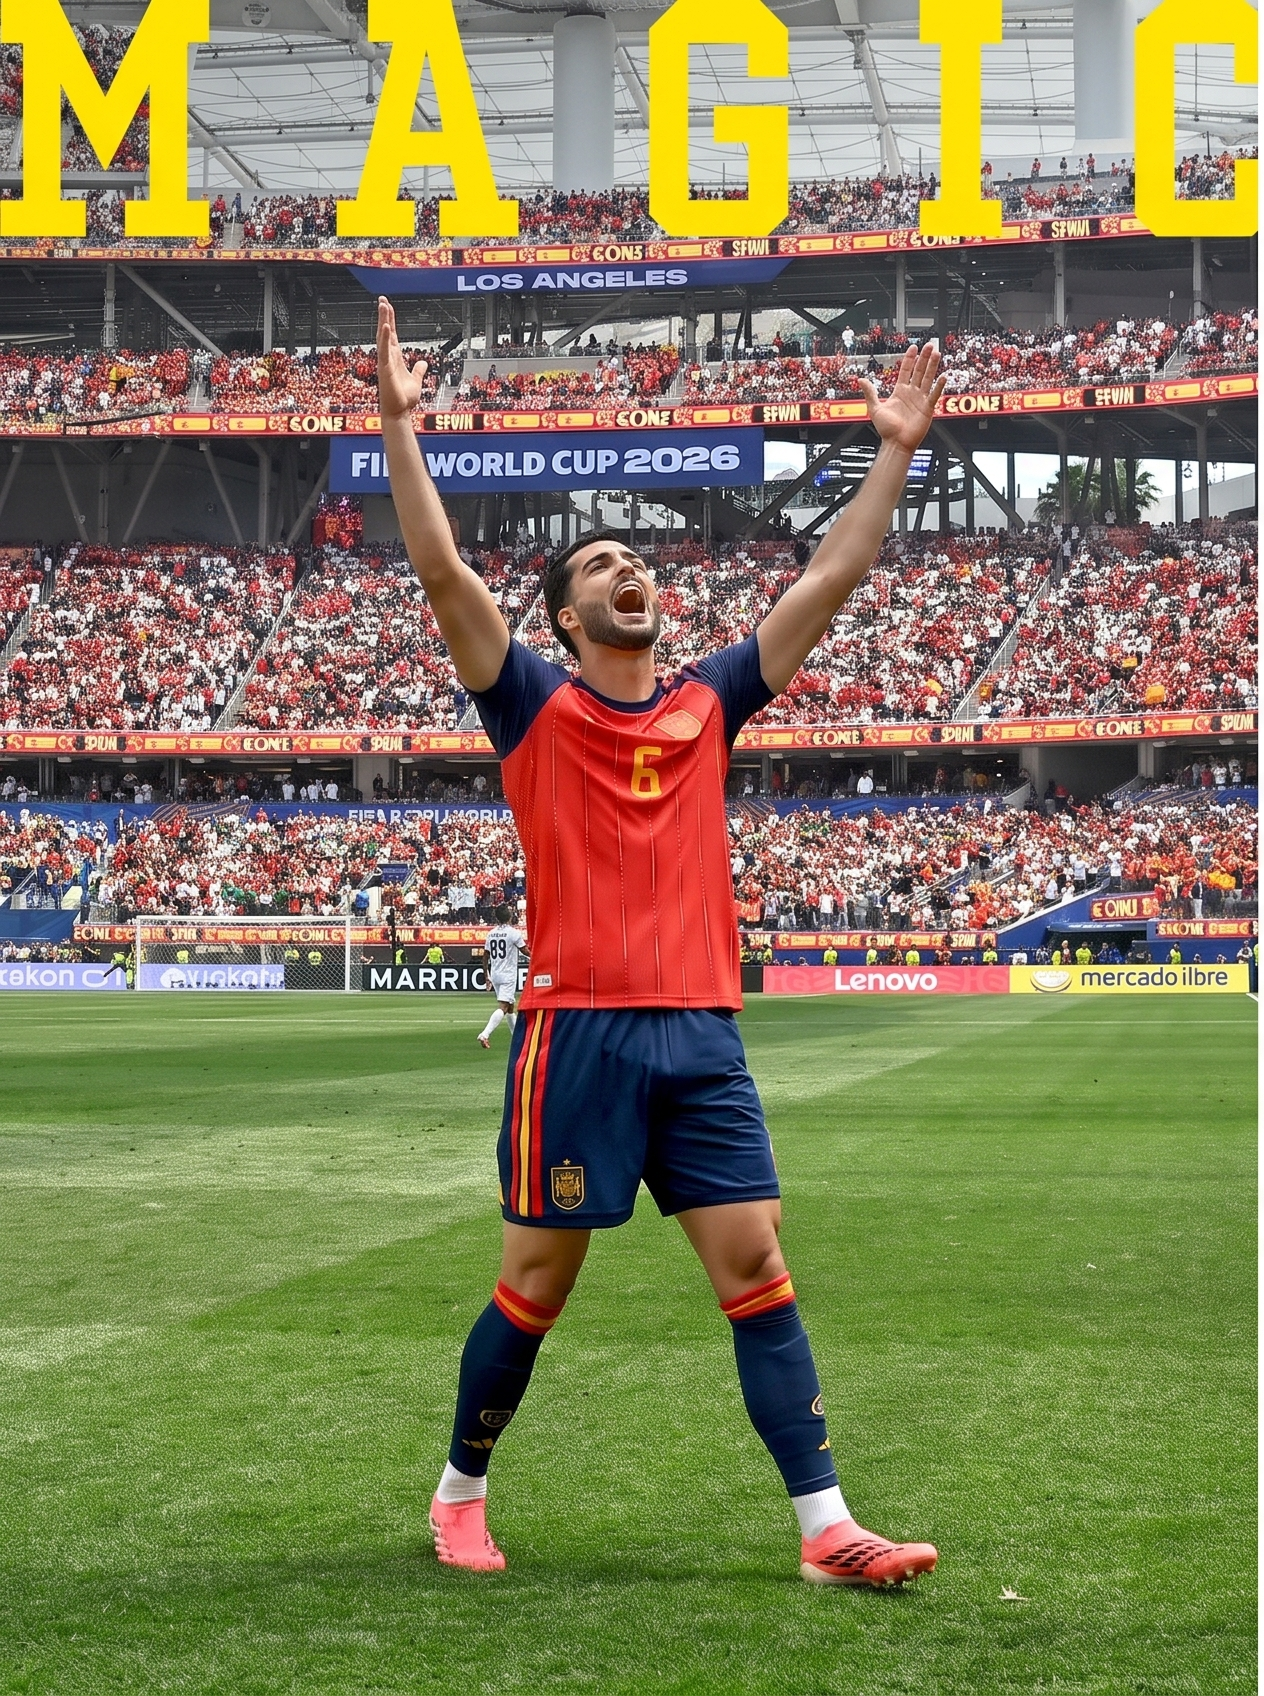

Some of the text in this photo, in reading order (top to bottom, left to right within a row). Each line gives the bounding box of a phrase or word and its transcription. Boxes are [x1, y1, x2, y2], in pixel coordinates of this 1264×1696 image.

[457, 269, 688, 291] LOS ANGELES
[352, 444, 741, 476] FI WORLD CUP 2026
[630, 745, 663, 798] 6
[489, 938, 507, 959] 89
[834, 968, 938, 991] Lenovo
[1081, 966, 1178, 987] mercado
[1182, 966, 1228, 986] ilbre
